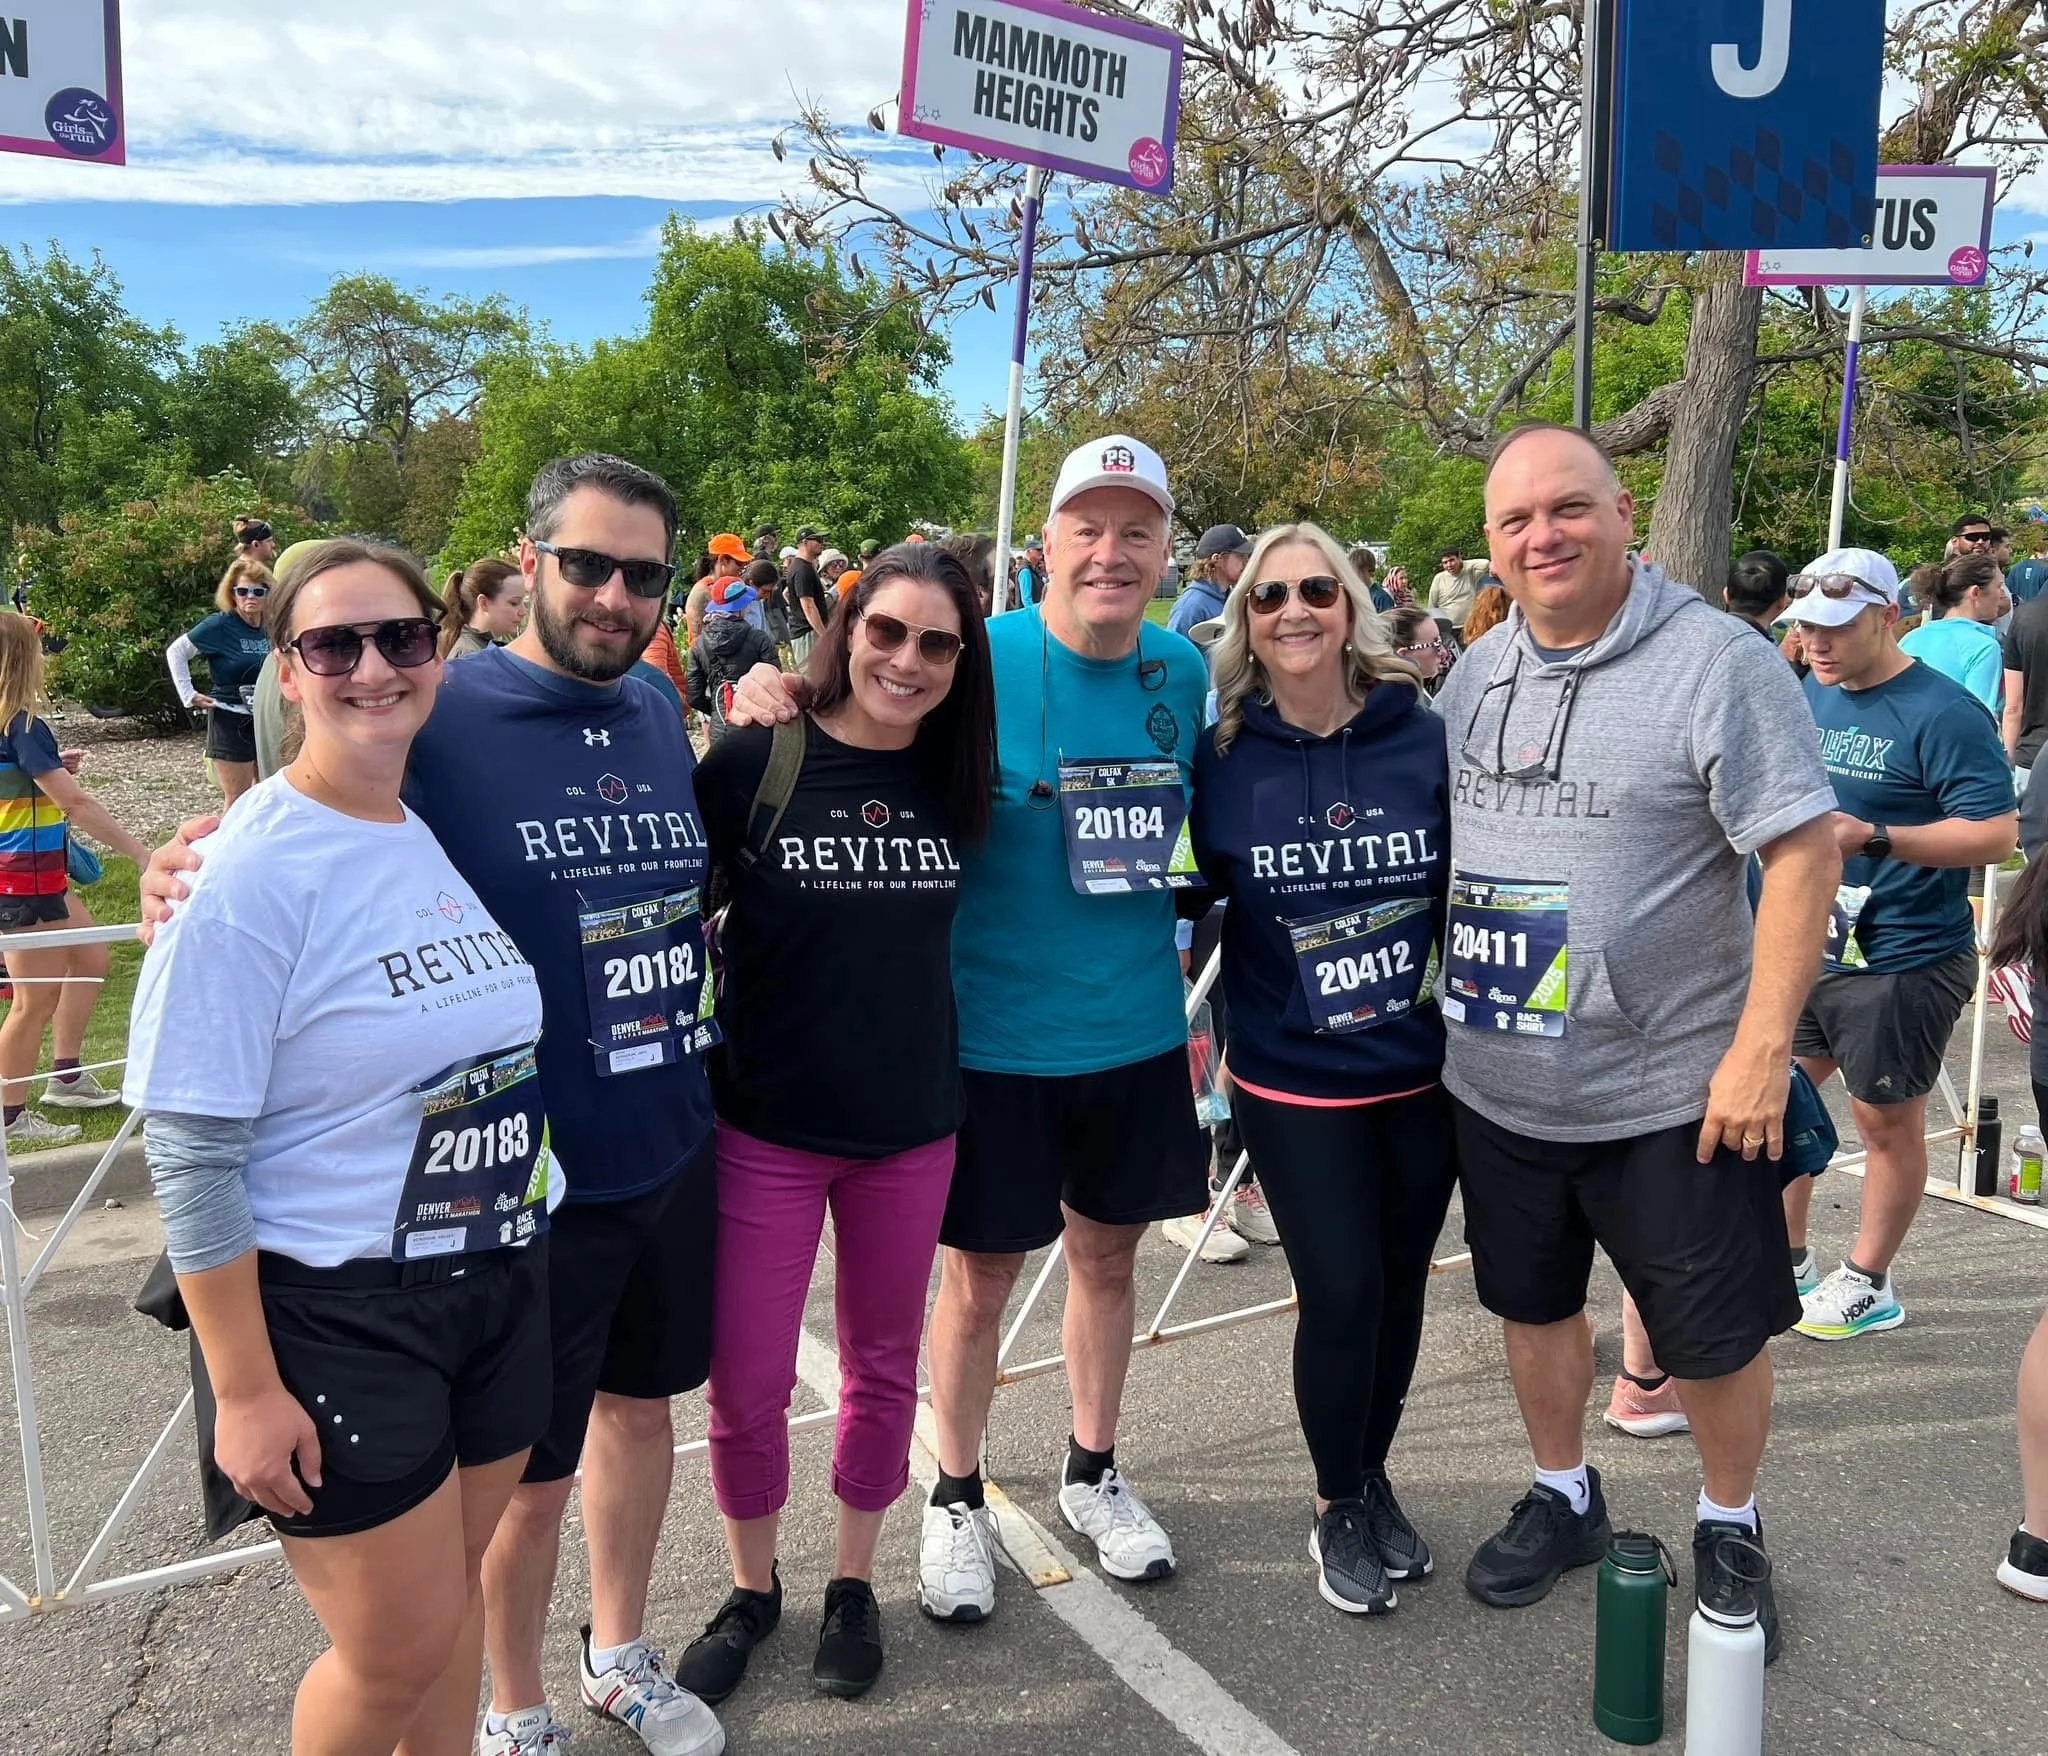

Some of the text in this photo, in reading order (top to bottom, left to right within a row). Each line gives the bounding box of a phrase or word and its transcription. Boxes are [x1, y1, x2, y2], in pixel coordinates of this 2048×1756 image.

[953, 10, 1127, 99] MAMMOTH
[1711, 0, 1792, 98] J
[974, 69, 1100, 142] HEIGHTS
[52, 120, 85, 135] Girls
[70, 133, 95, 145] run
[1098, 767, 1122, 777] COLFAX
[566, 784, 652, 796] COL USA
[1454, 768, 1610, 818] REVITAL
[830, 810, 915, 819] COL USA
[1075, 806, 1164, 840] 20184
[1298, 807, 1384, 825] CL USA
[515, 812, 708, 861] REVITAL
[779, 837, 960, 871] REVITAL
[1171, 833, 1190, 871] 2025
[1250, 829, 1438, 878] REVITAL
[551, 858, 704, 881] A LIFELINE FOR OUR FRONTLINE
[800, 880, 956, 889] A LIFELINE FOR OUR FRONTLINE
[1270, 871, 1427, 894] A LIFELINE FOR OUR FRONTLINE
[416, 908, 433, 919] COL
[631, 903, 660, 919] COLFAX
[642, 915, 653, 928] 5K
[1334, 914, 1361, 930] COLFAX
[1452, 921, 1527, 968] 20411
[604, 942, 698, 999] 20182
[1315, 940, 1414, 996] 20412
[1420, 959, 1438, 996] 2025
[1533, 967, 1565, 1007] 2025
[421, 1004, 429, 1014] A
[436, 987, 482, 1009] LIFELINE
[485, 983, 499, 993] FOR
[501, 979, 515, 990] OUR
[1328, 1012, 1353, 1025] DENVER
[1516, 1012, 1544, 1023] RACE
[611, 1020, 641, 1036] DENVER
[1516, 1021, 1545, 1033] SHIRT
[470, 1067, 490, 1086] COLFAX
[478, 1083, 487, 1096] 5K
[424, 1112, 529, 1175] 20183
[526, 1143, 549, 1198] 2025
[416, 1209, 481, 1222] COLFAX MARATHON
[417, 1202, 450, 1217] DENVER
[516, 1210, 533, 1226] RACE
[516, 1221, 536, 1238] SHIRT
[1840, 1294, 1876, 1324] HOKA
[517, 1716, 540, 1730] XERO
